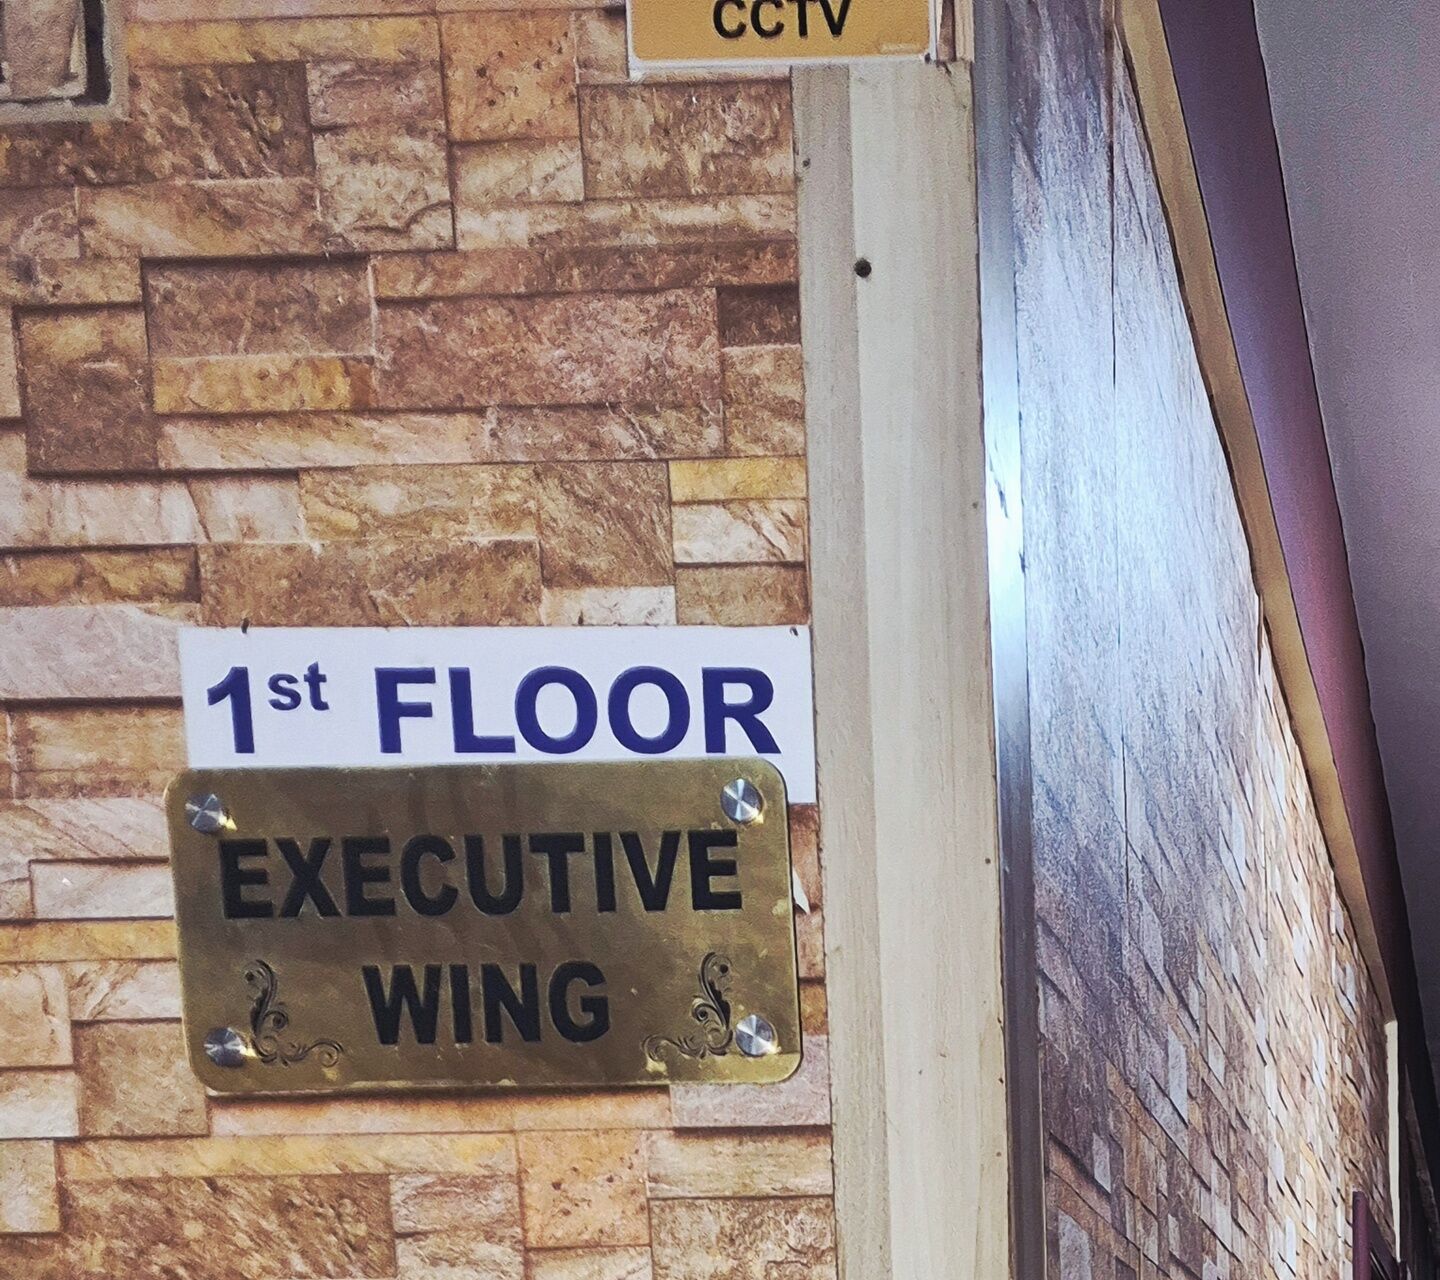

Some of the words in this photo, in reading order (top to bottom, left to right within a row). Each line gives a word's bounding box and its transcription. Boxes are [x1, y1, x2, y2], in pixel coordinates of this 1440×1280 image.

[712, 0, 851, 39] CCTV
[206, 661, 331, 754] 1st
[375, 665, 781, 755] FLOOR
[218, 829, 743, 919] EXECUTIVE
[362, 961, 611, 1046] WING
